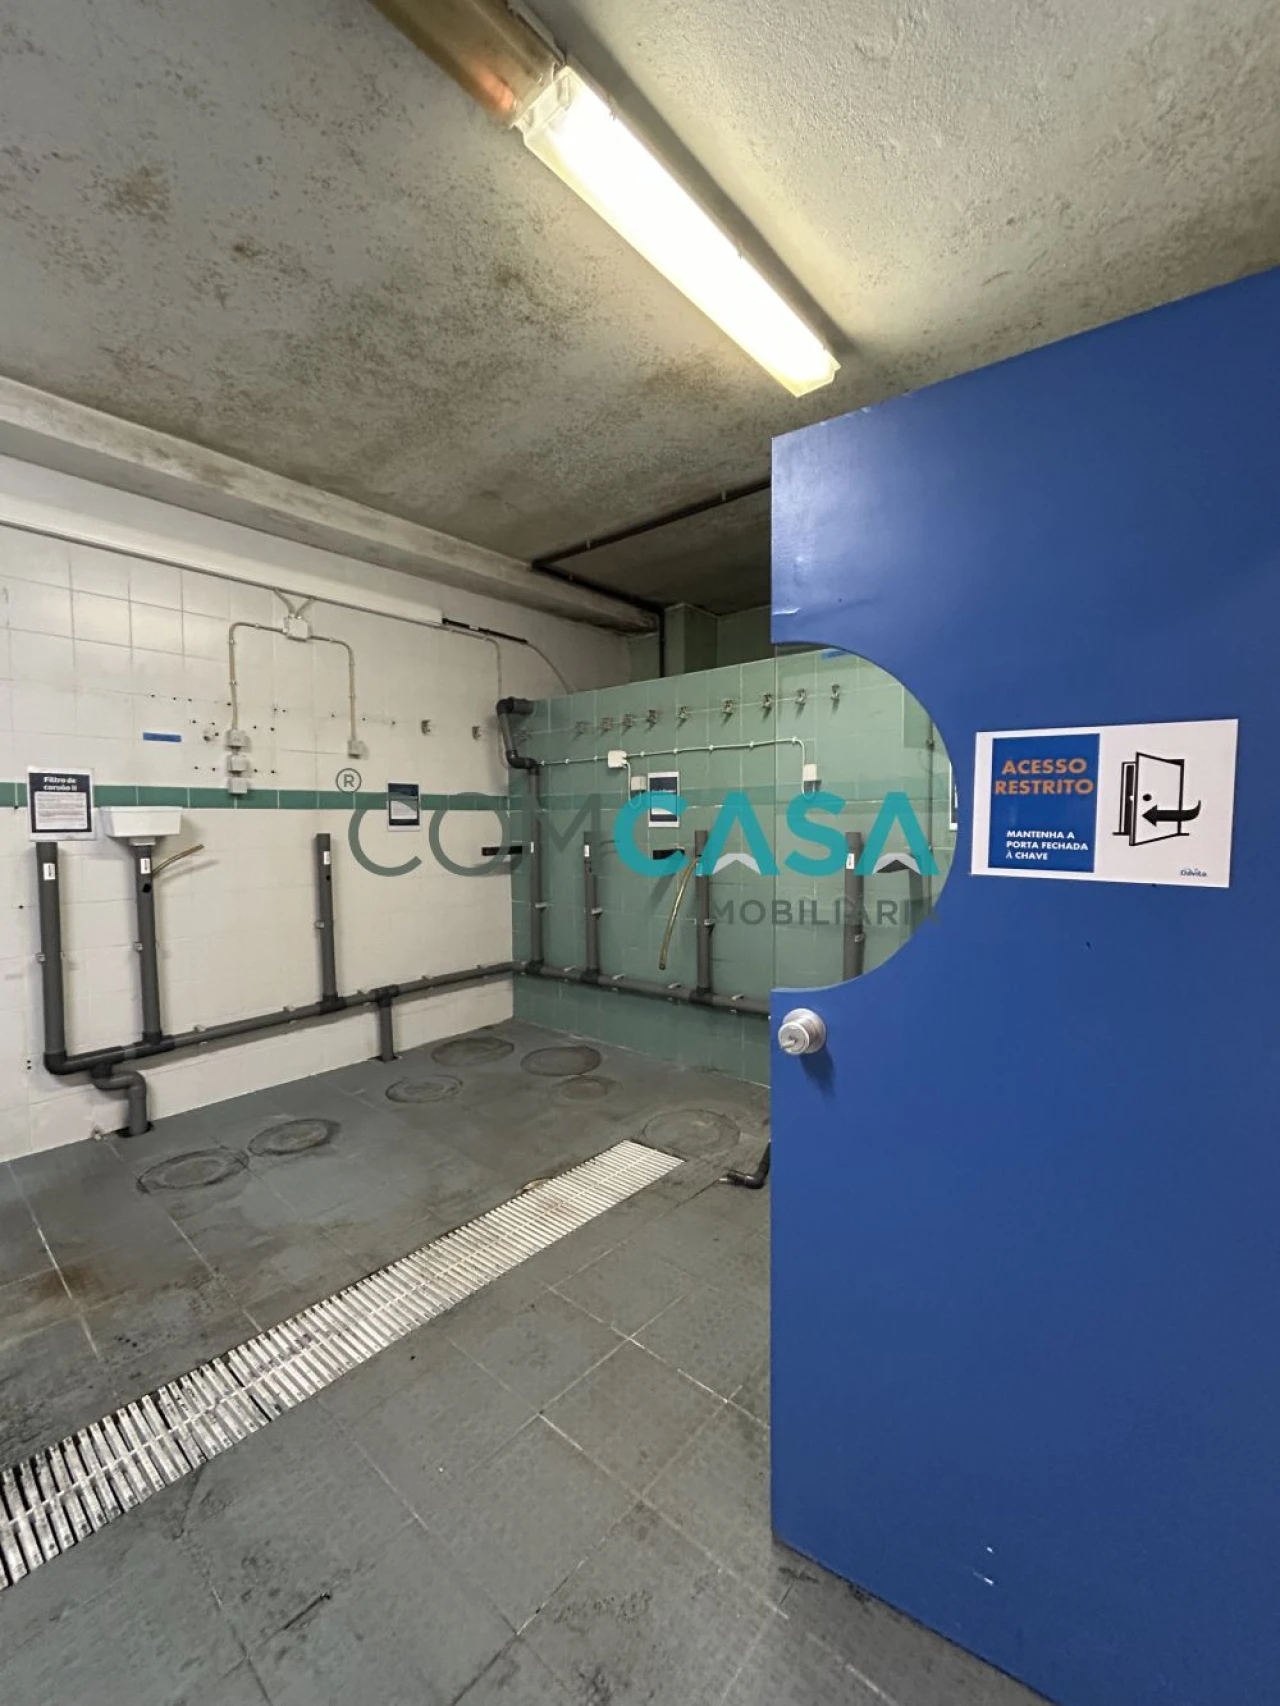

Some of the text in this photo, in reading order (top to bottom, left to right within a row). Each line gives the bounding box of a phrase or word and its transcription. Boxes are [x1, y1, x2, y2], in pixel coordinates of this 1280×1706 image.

[1002, 758, 1087, 774] ACESSO
[995, 778, 1094, 795] RESTRITO
[1006, 830, 1075, 839] MANTENHA A
[1006, 841, 1089, 850] PORTA FECHADA
[1014, 852, 1048, 860] CHAVE
